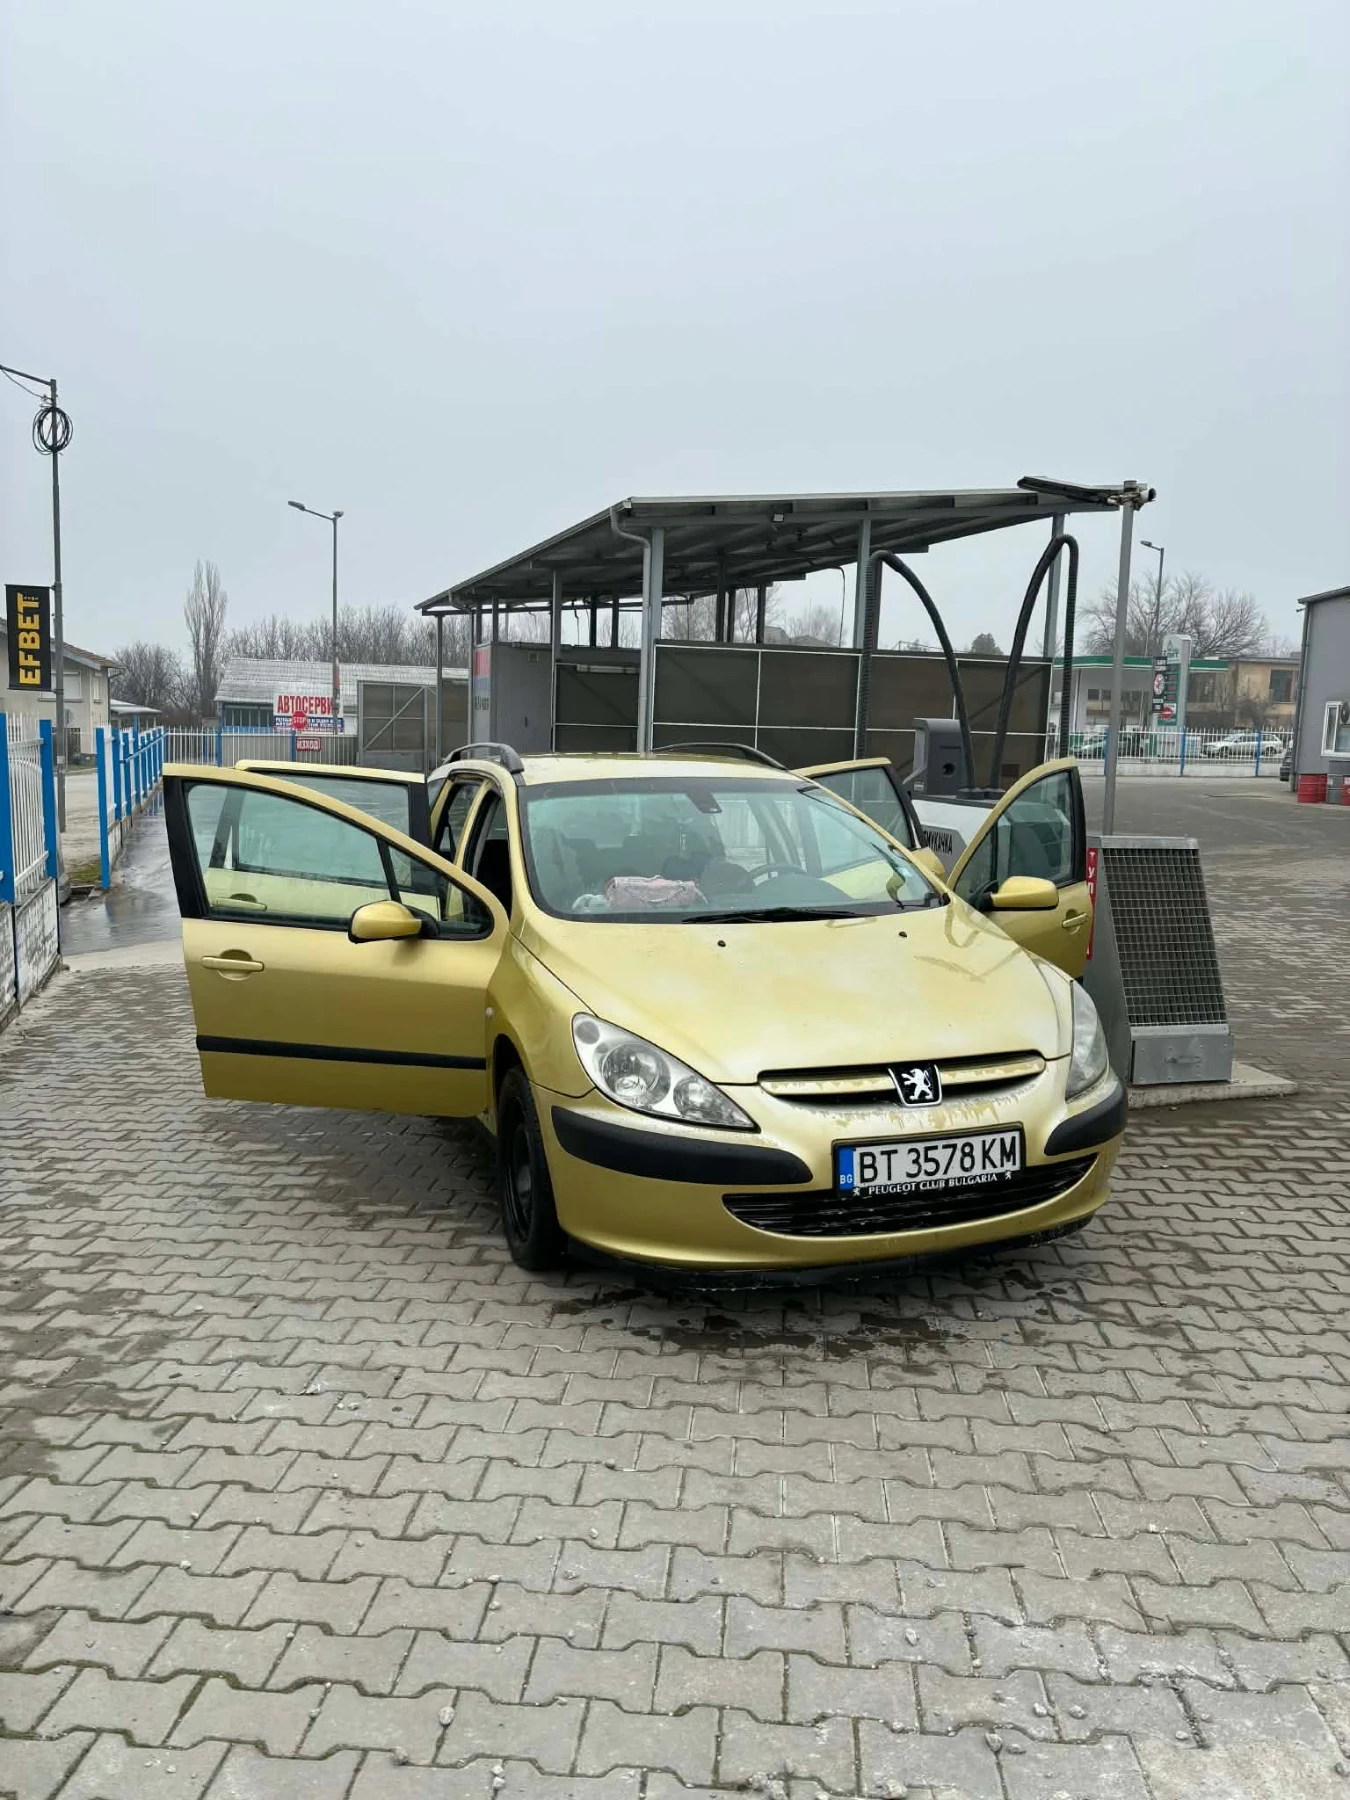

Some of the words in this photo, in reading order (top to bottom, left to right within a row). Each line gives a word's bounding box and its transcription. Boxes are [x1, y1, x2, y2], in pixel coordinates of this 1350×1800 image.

[17, 592, 41, 685] EFBET
[277, 695, 339, 715] АВТОСЕРВИ
[293, 716, 305, 724] STOP
[923, 830, 953, 855] МУКАЧКА
[859, 1149, 898, 1184] BT
[906, 1142, 975, 1179] 3578
[982, 1136, 1016, 1170] KM
[840, 1173, 853, 1184] BG
[868, 1182, 917, 1195] PEUGEOT
[920, 1179, 946, 1190] CLUB
[948, 1173, 998, 1187] BULGARIA
